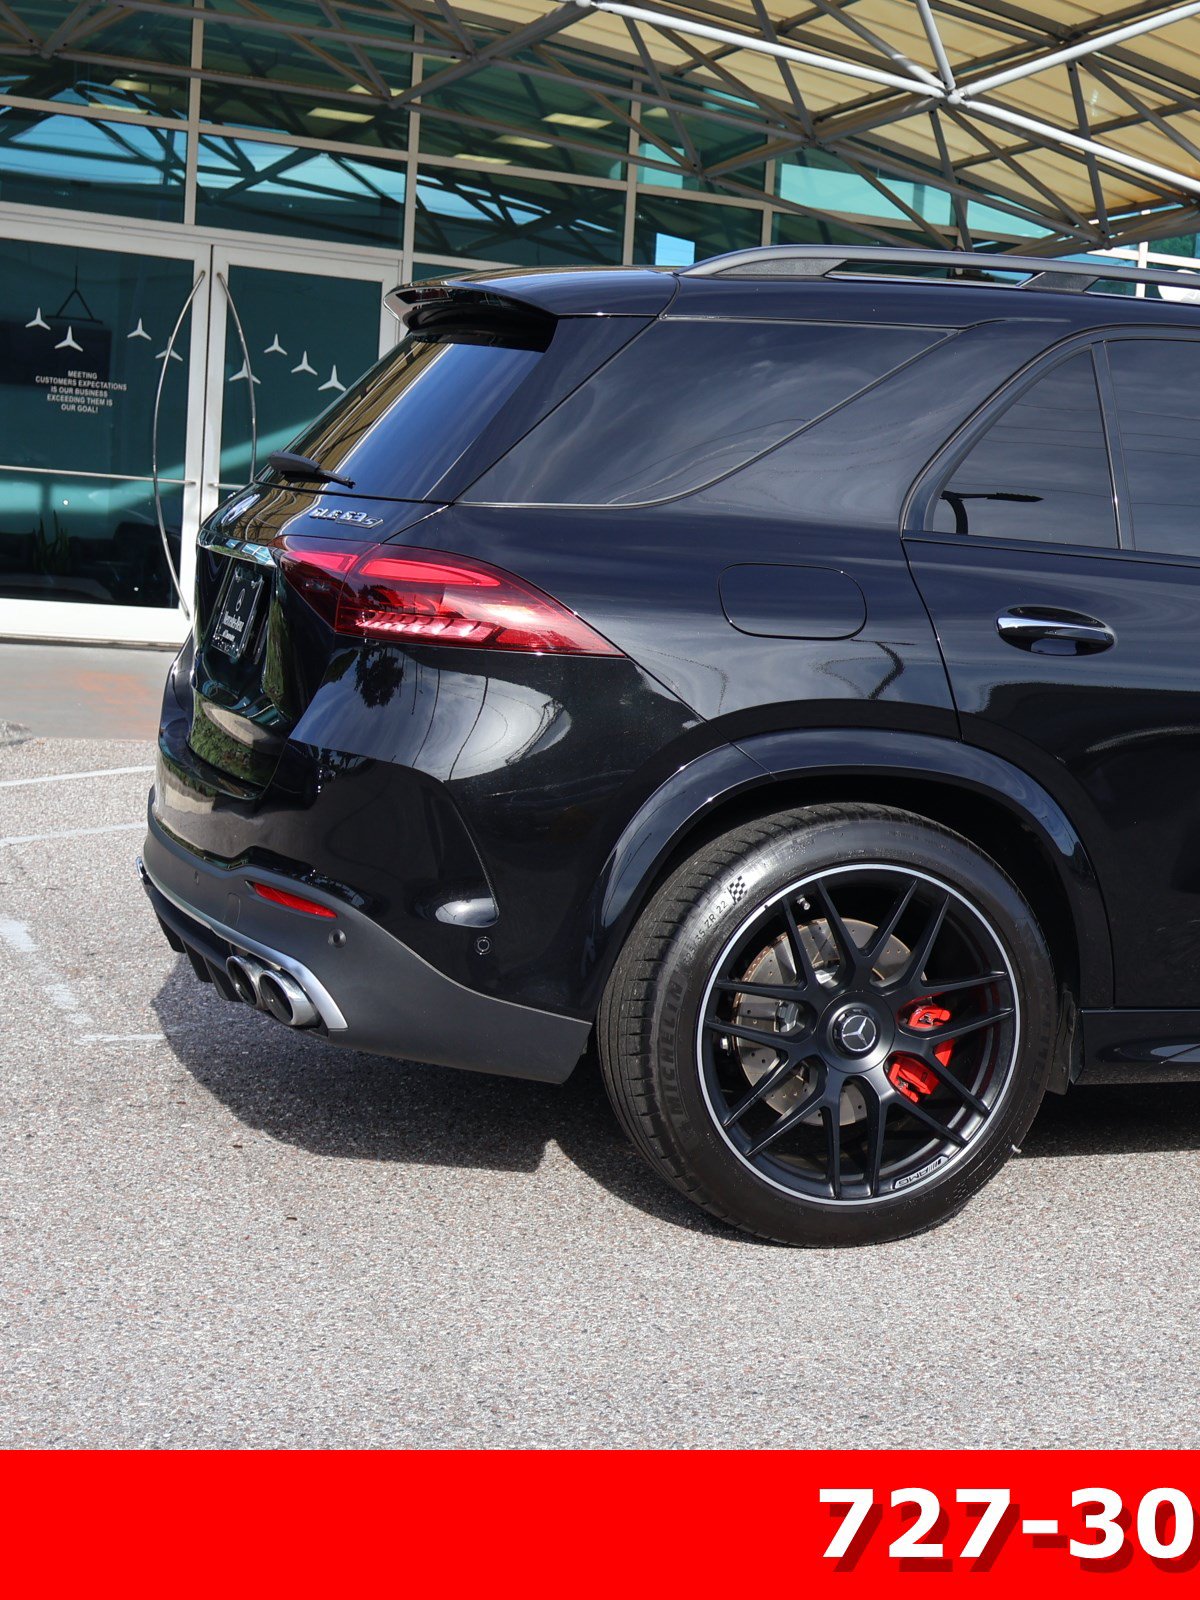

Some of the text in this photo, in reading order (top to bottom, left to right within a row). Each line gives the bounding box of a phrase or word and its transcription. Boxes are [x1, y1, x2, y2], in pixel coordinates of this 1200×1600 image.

[67, 370, 97, 379] MEETING
[35, 375, 128, 391] CUSTOMERS EXPECTATIONS
[58, 386, 74, 395] OUR
[74, 388, 108, 398] BUSINESS
[46, 393, 114, 407] EXCEEDING THEM IS
[60, 403, 76, 411] OUR
